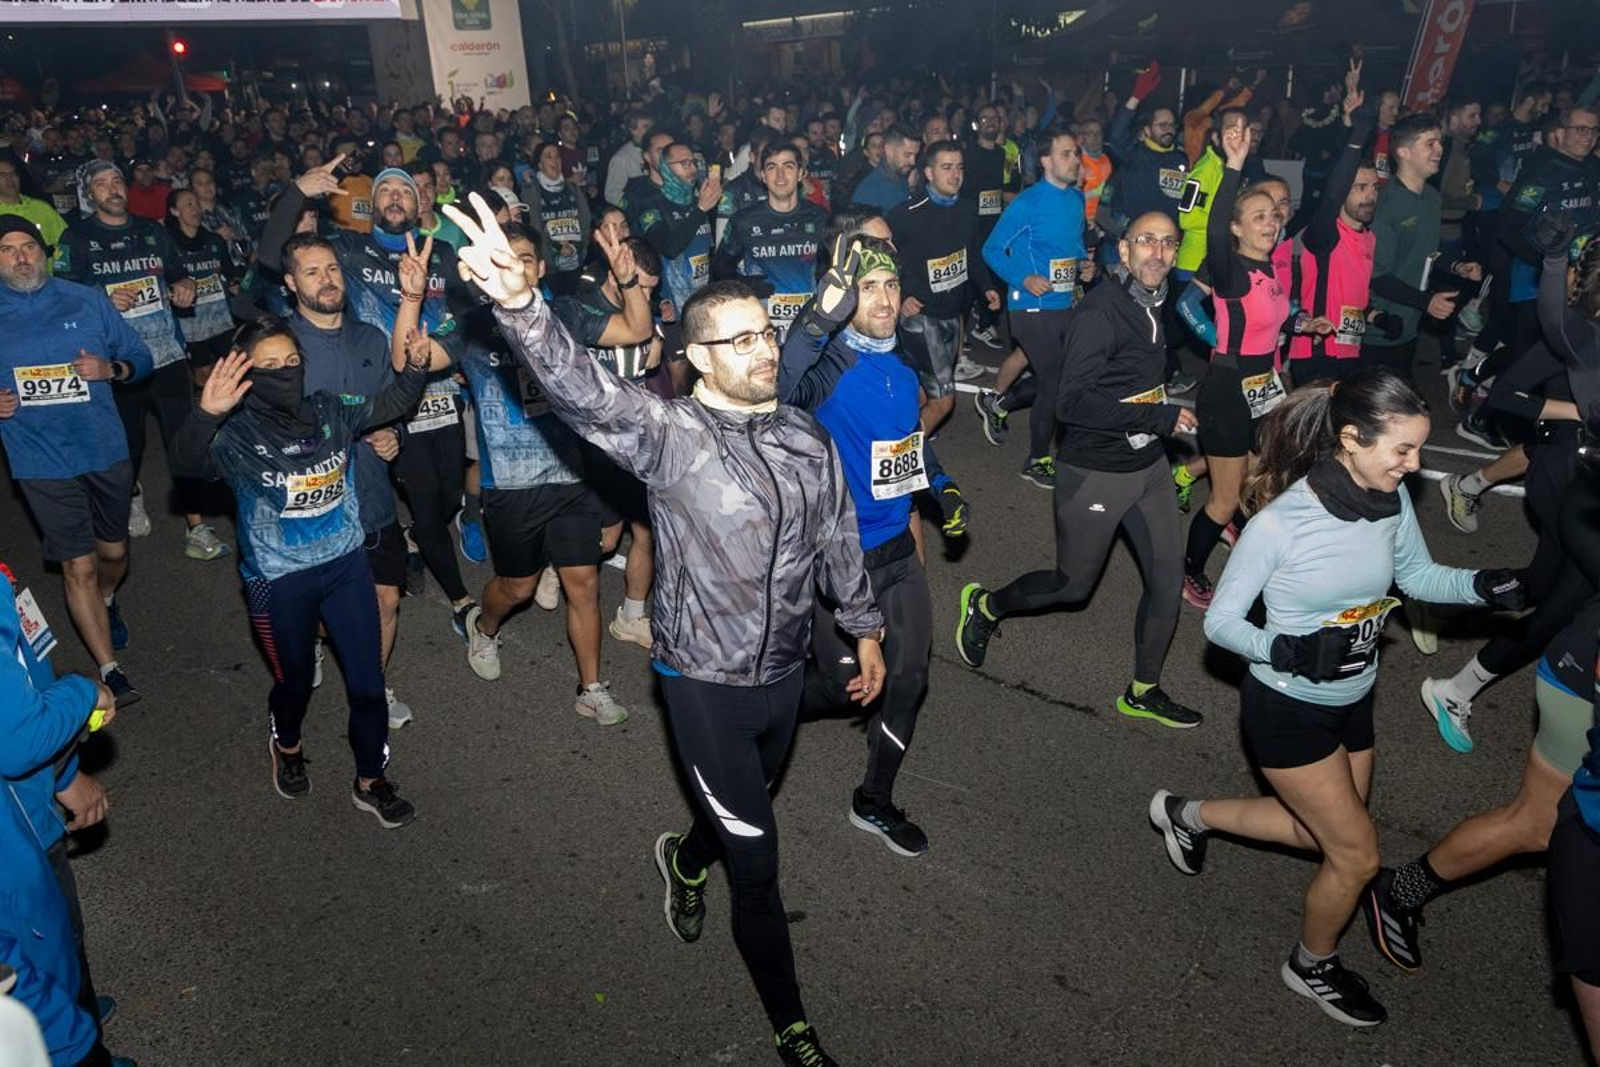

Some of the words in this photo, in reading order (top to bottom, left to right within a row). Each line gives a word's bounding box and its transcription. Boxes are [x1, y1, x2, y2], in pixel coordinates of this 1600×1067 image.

[450, 41, 501, 52] calderón
[752, 245, 777, 258] SAN
[779, 240, 817, 256] ANTÓN
[92, 260, 121, 275] SAN
[124, 253, 163, 272] ANTÓN
[932, 260, 964, 280] 8497
[362, 267, 396, 285] SAN
[23, 376, 82, 395] 9974
[420, 397, 451, 414] 453
[878, 450, 919, 478] 8688
[293, 479, 344, 506] 9988
